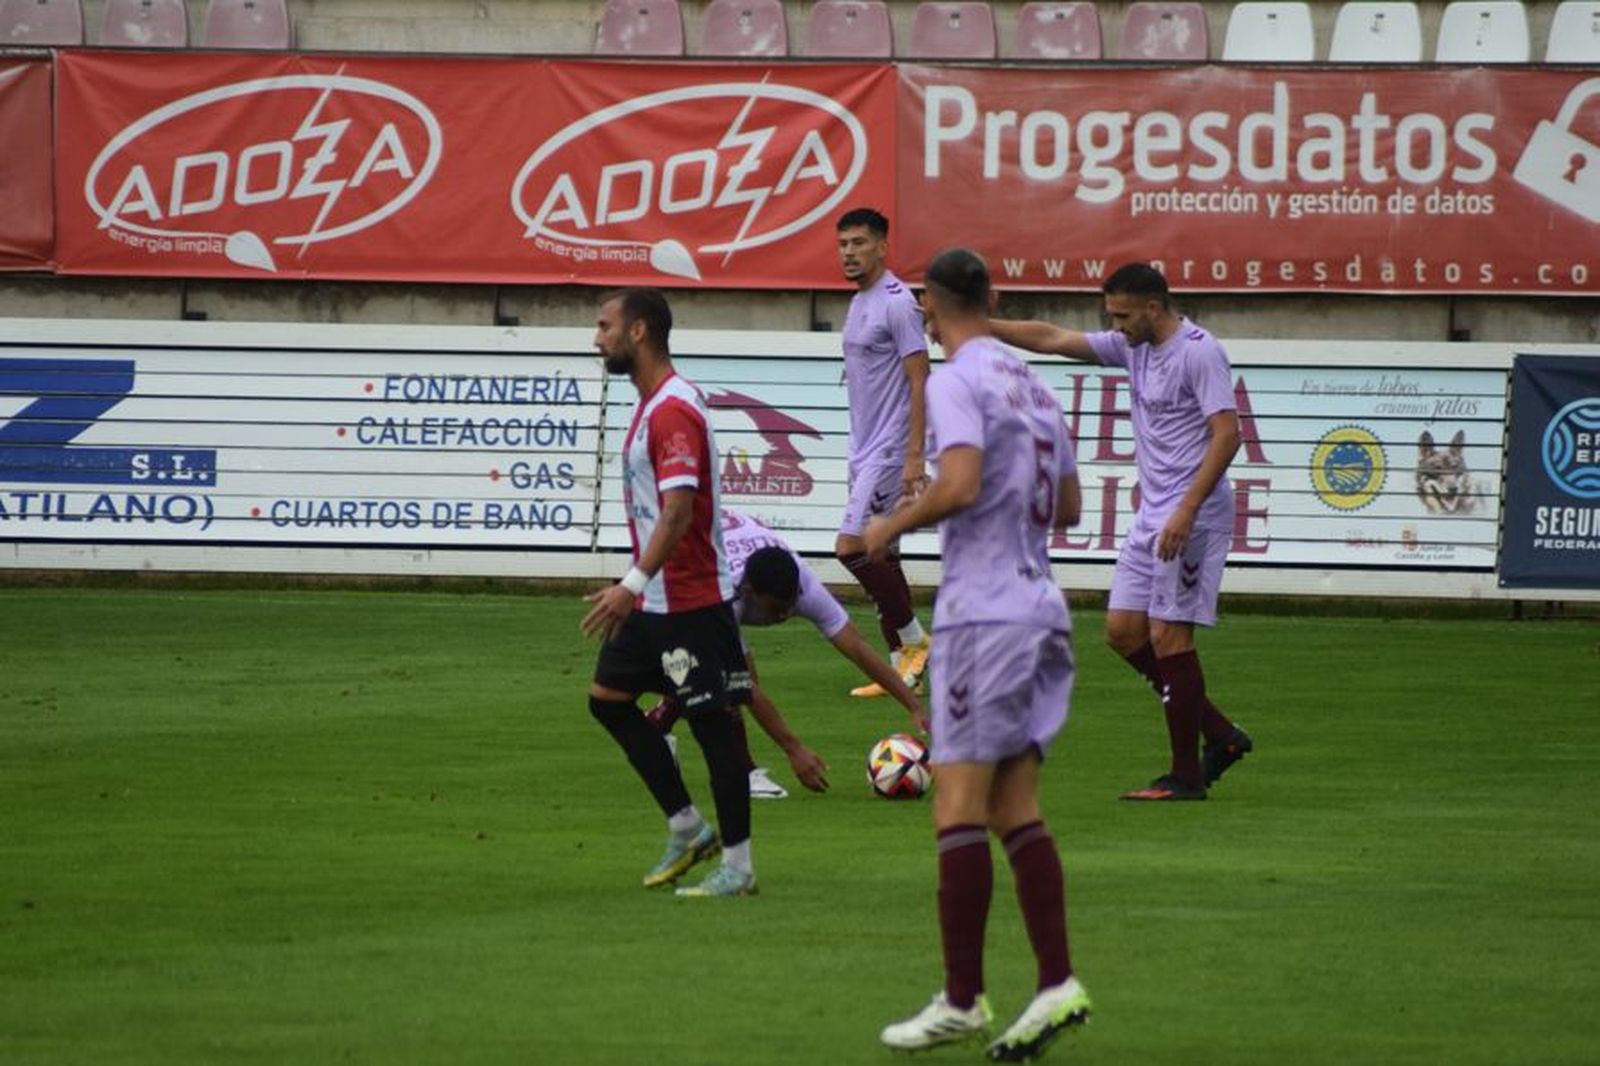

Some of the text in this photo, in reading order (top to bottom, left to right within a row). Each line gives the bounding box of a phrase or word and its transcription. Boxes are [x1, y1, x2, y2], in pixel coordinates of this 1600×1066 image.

[923, 82, 1498, 203] Progesdatos
[98, 118, 414, 230] ADOZA
[523, 126, 839, 239] ADOZA
[1131, 186, 1495, 219] protección y gestión de datos
[175, 236, 224, 255] limpia
[600, 245, 647, 262] limpia
[383, 370, 582, 404] FONTANERÍA
[356, 412, 578, 447] CALEFACCIÓN
[131, 454, 209, 481] S.L.
[509, 461, 576, 490] GAS
[1030, 437, 1055, 527] 5
[270, 497, 573, 531] CUARTOS DE BAÑO
[1533, 539, 1600, 550] FEDERA
